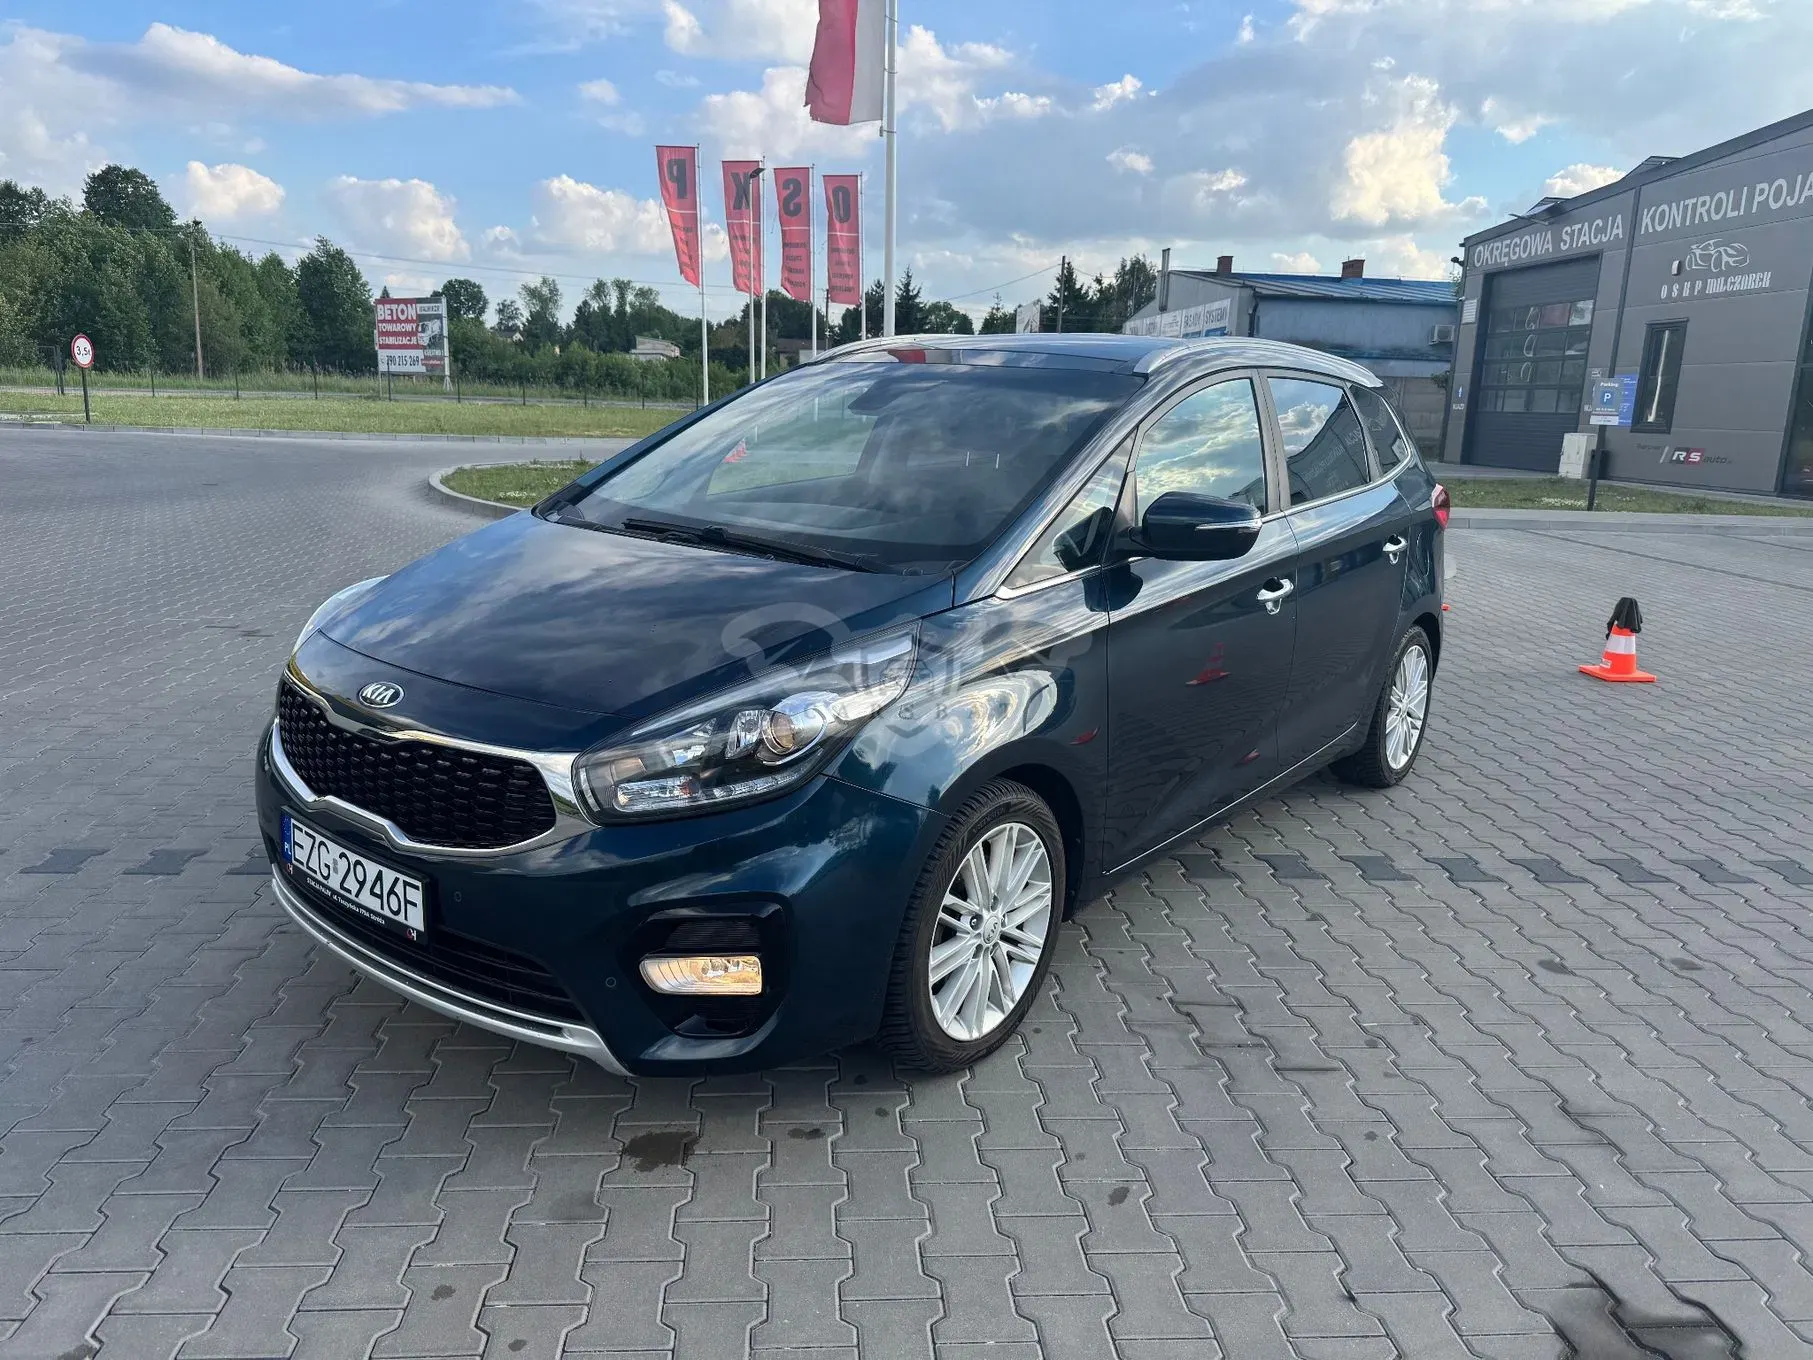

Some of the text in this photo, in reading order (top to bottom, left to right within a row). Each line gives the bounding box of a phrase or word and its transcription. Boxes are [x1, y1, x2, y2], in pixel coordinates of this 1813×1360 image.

[1473, 230, 1552, 268] OKRĘGOWA
[1560, 213, 1623, 251] STACJA
[1640, 186, 1747, 235] KONTROLI
[1705, 271, 1772, 294] MILCZAREK
[377, 303, 416, 320] BETON
[378, 323, 416, 332] TOWAROWY
[379, 336, 417, 345] STABILIZACJE
[398, 355, 407, 366] 215
[409, 355, 419, 366] 269
[362, 682, 395, 704] KIA
[284, 841, 292, 855] PL
[292, 822, 421, 922] EZG 2946F
